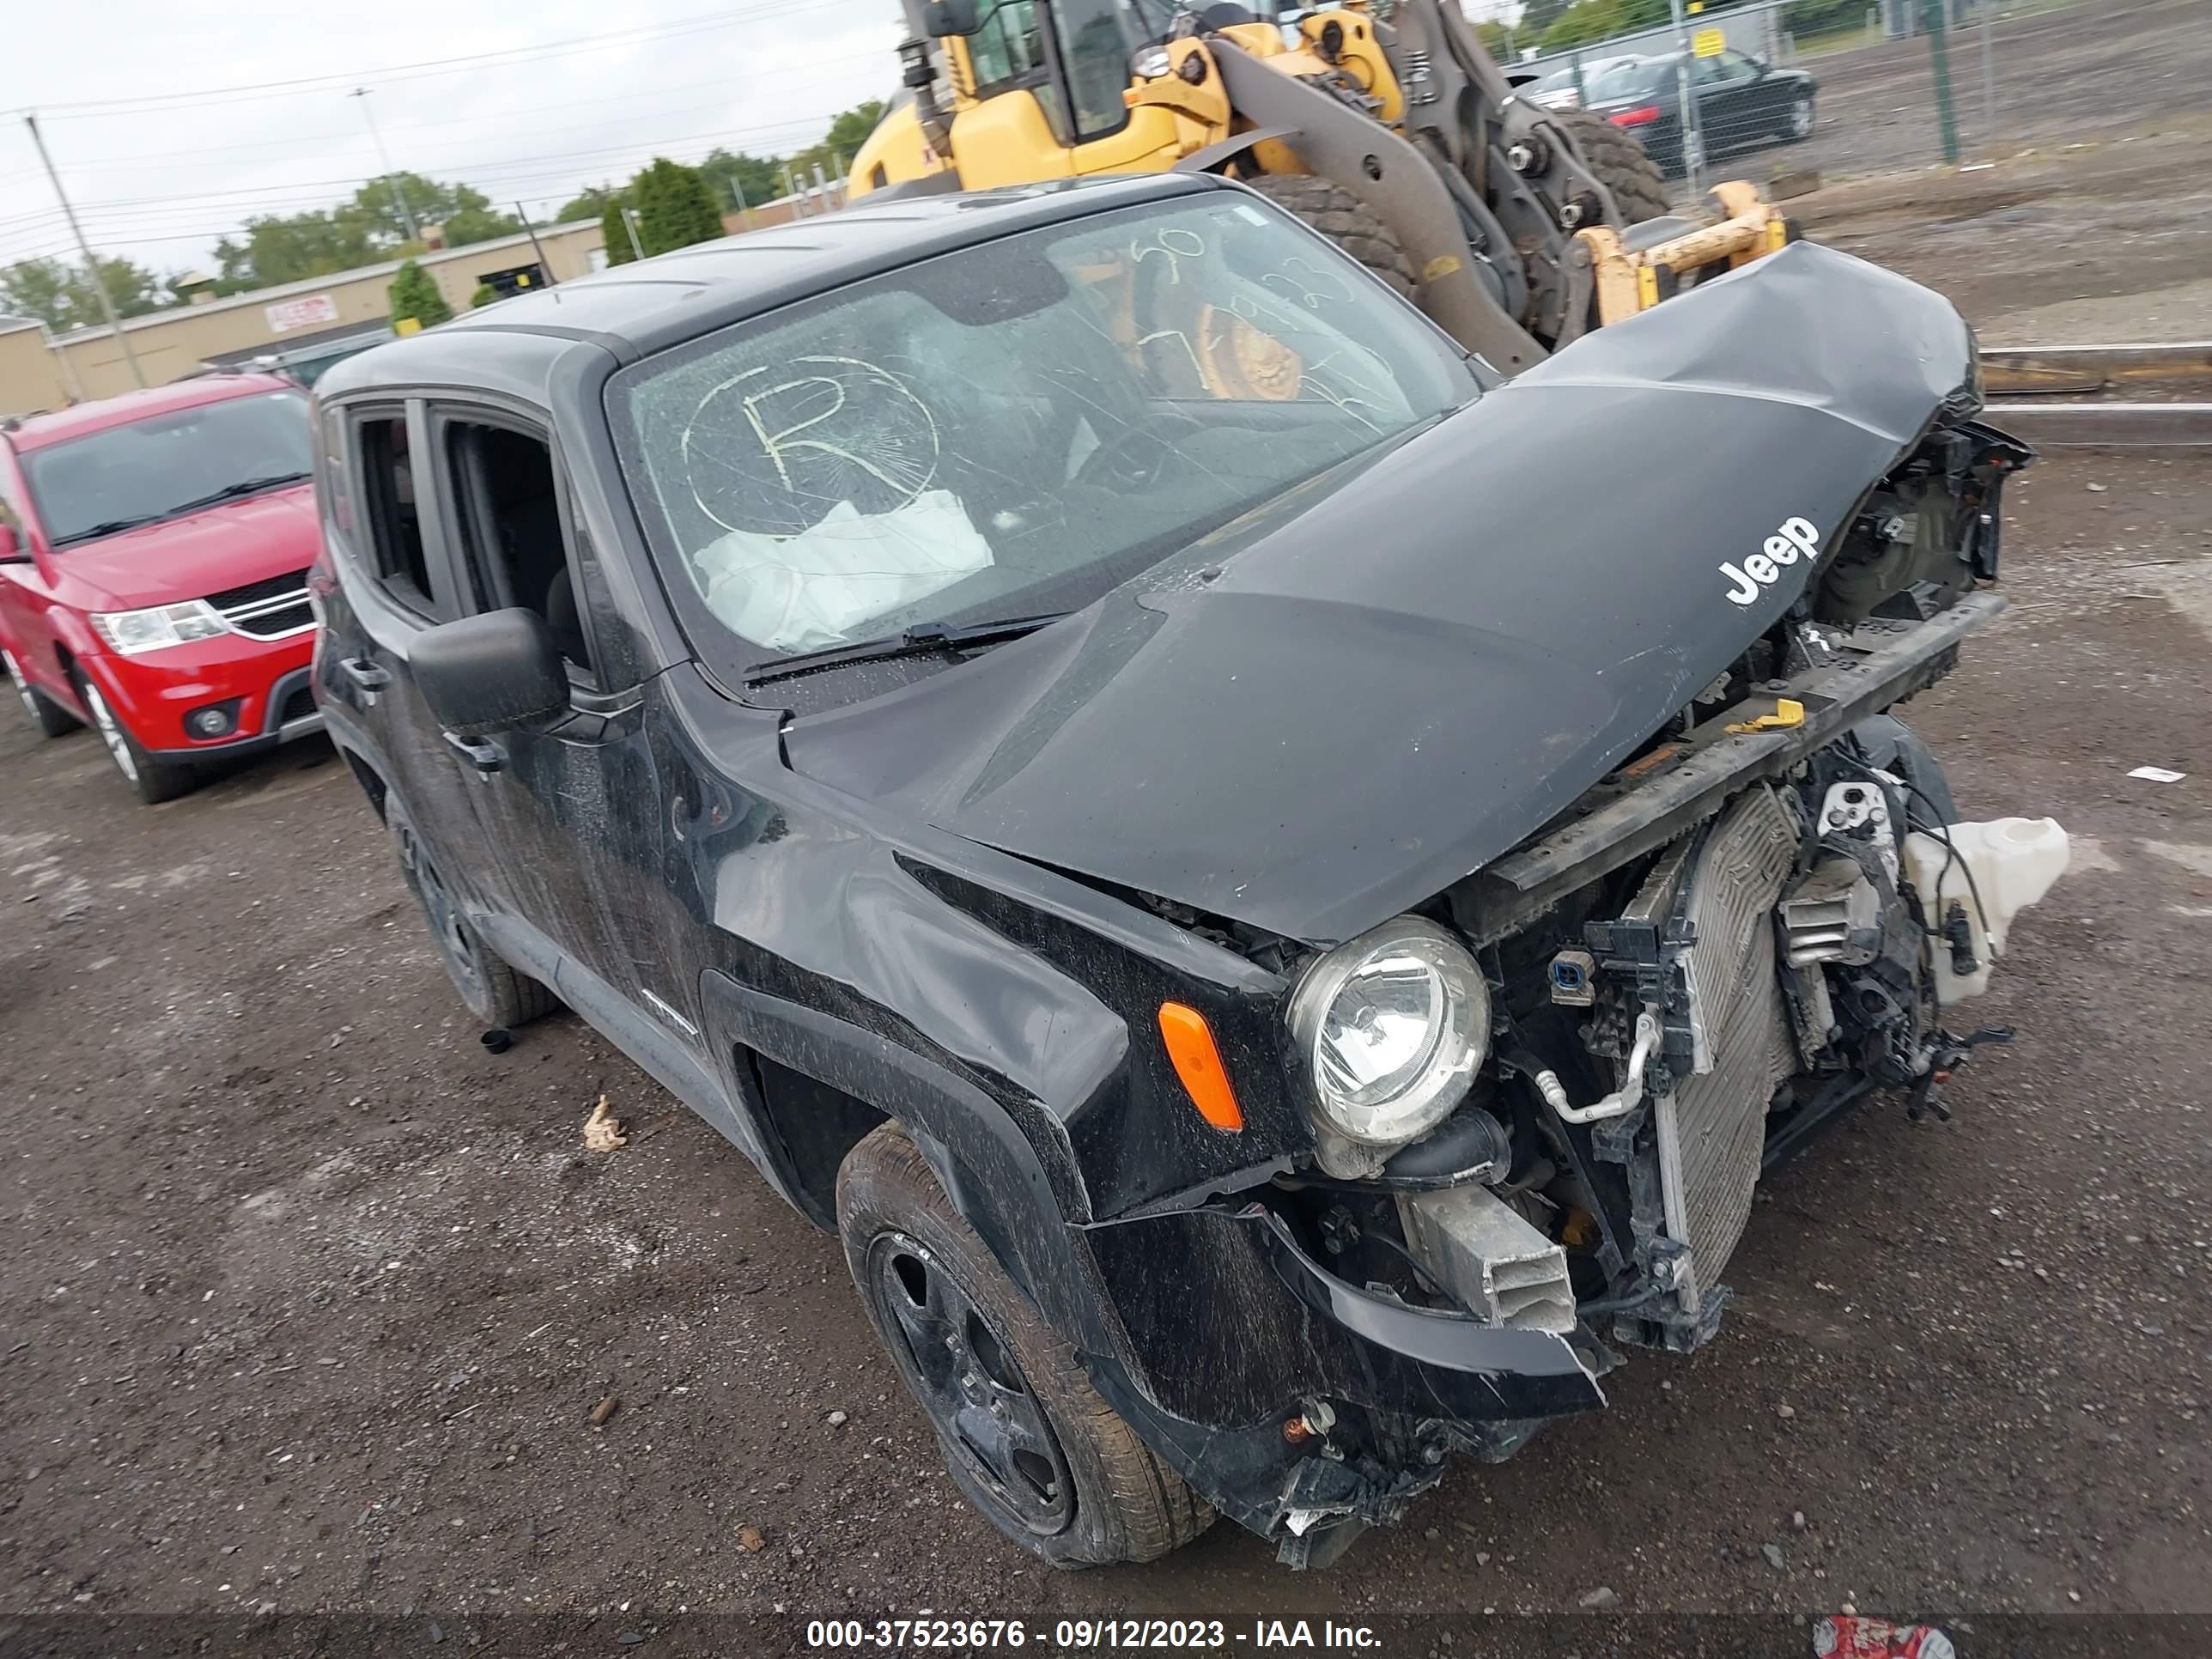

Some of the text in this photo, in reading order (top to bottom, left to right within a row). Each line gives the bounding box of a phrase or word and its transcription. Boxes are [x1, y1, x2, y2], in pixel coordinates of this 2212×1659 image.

[1130, 229, 1204, 284] 50
[743, 375, 922, 492] R
[1717, 517, 1820, 605] Jeep
